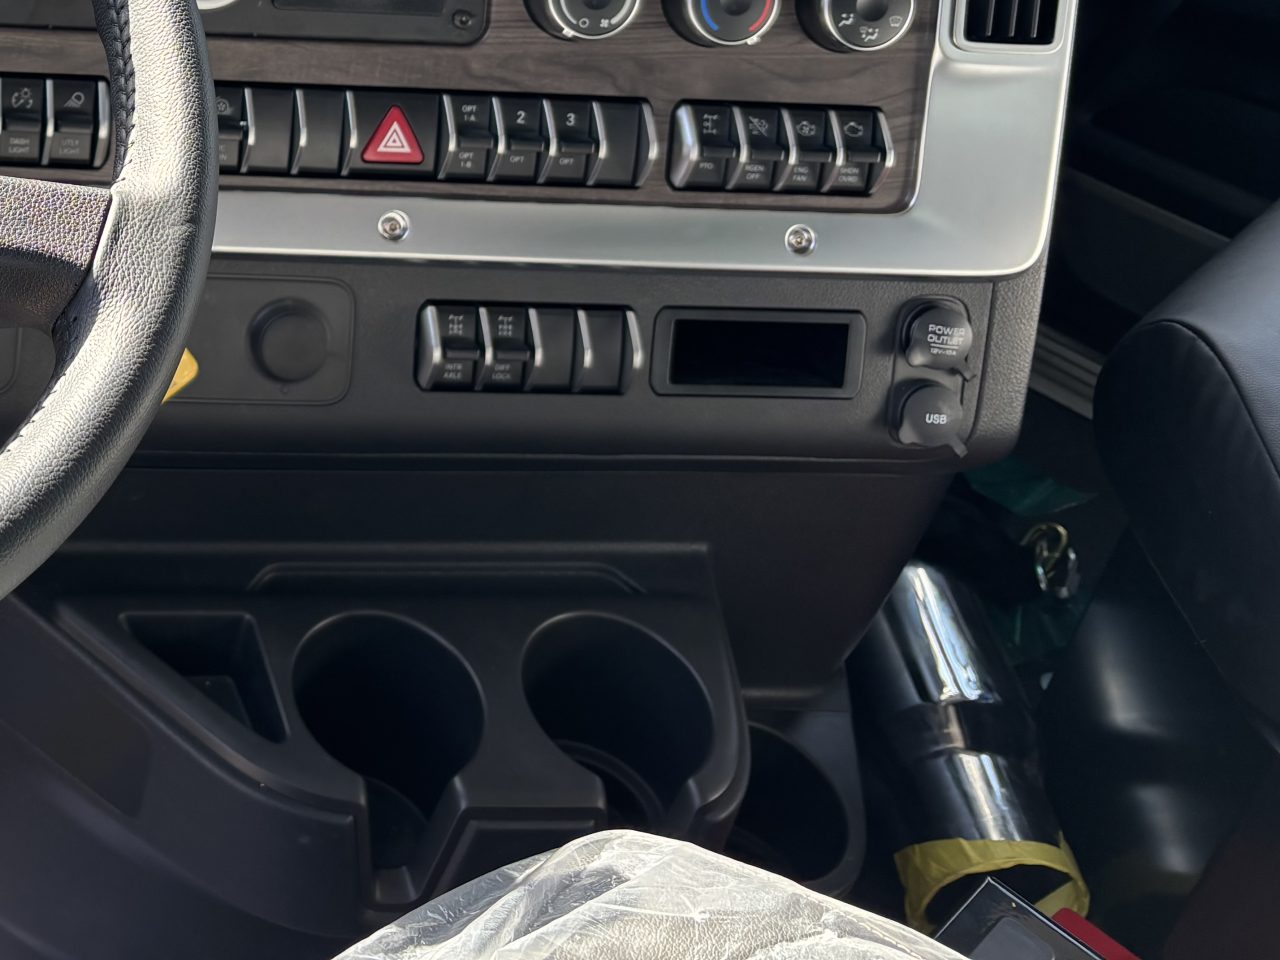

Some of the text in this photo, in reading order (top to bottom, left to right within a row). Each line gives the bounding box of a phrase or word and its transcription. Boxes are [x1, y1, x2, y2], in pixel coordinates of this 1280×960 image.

[516, 110, 526, 124] 2
[566, 112, 576, 126] 3
[928, 323, 966, 337] POWER
[927, 333, 964, 346] OUTLET
[925, 412, 948, 425] USB
